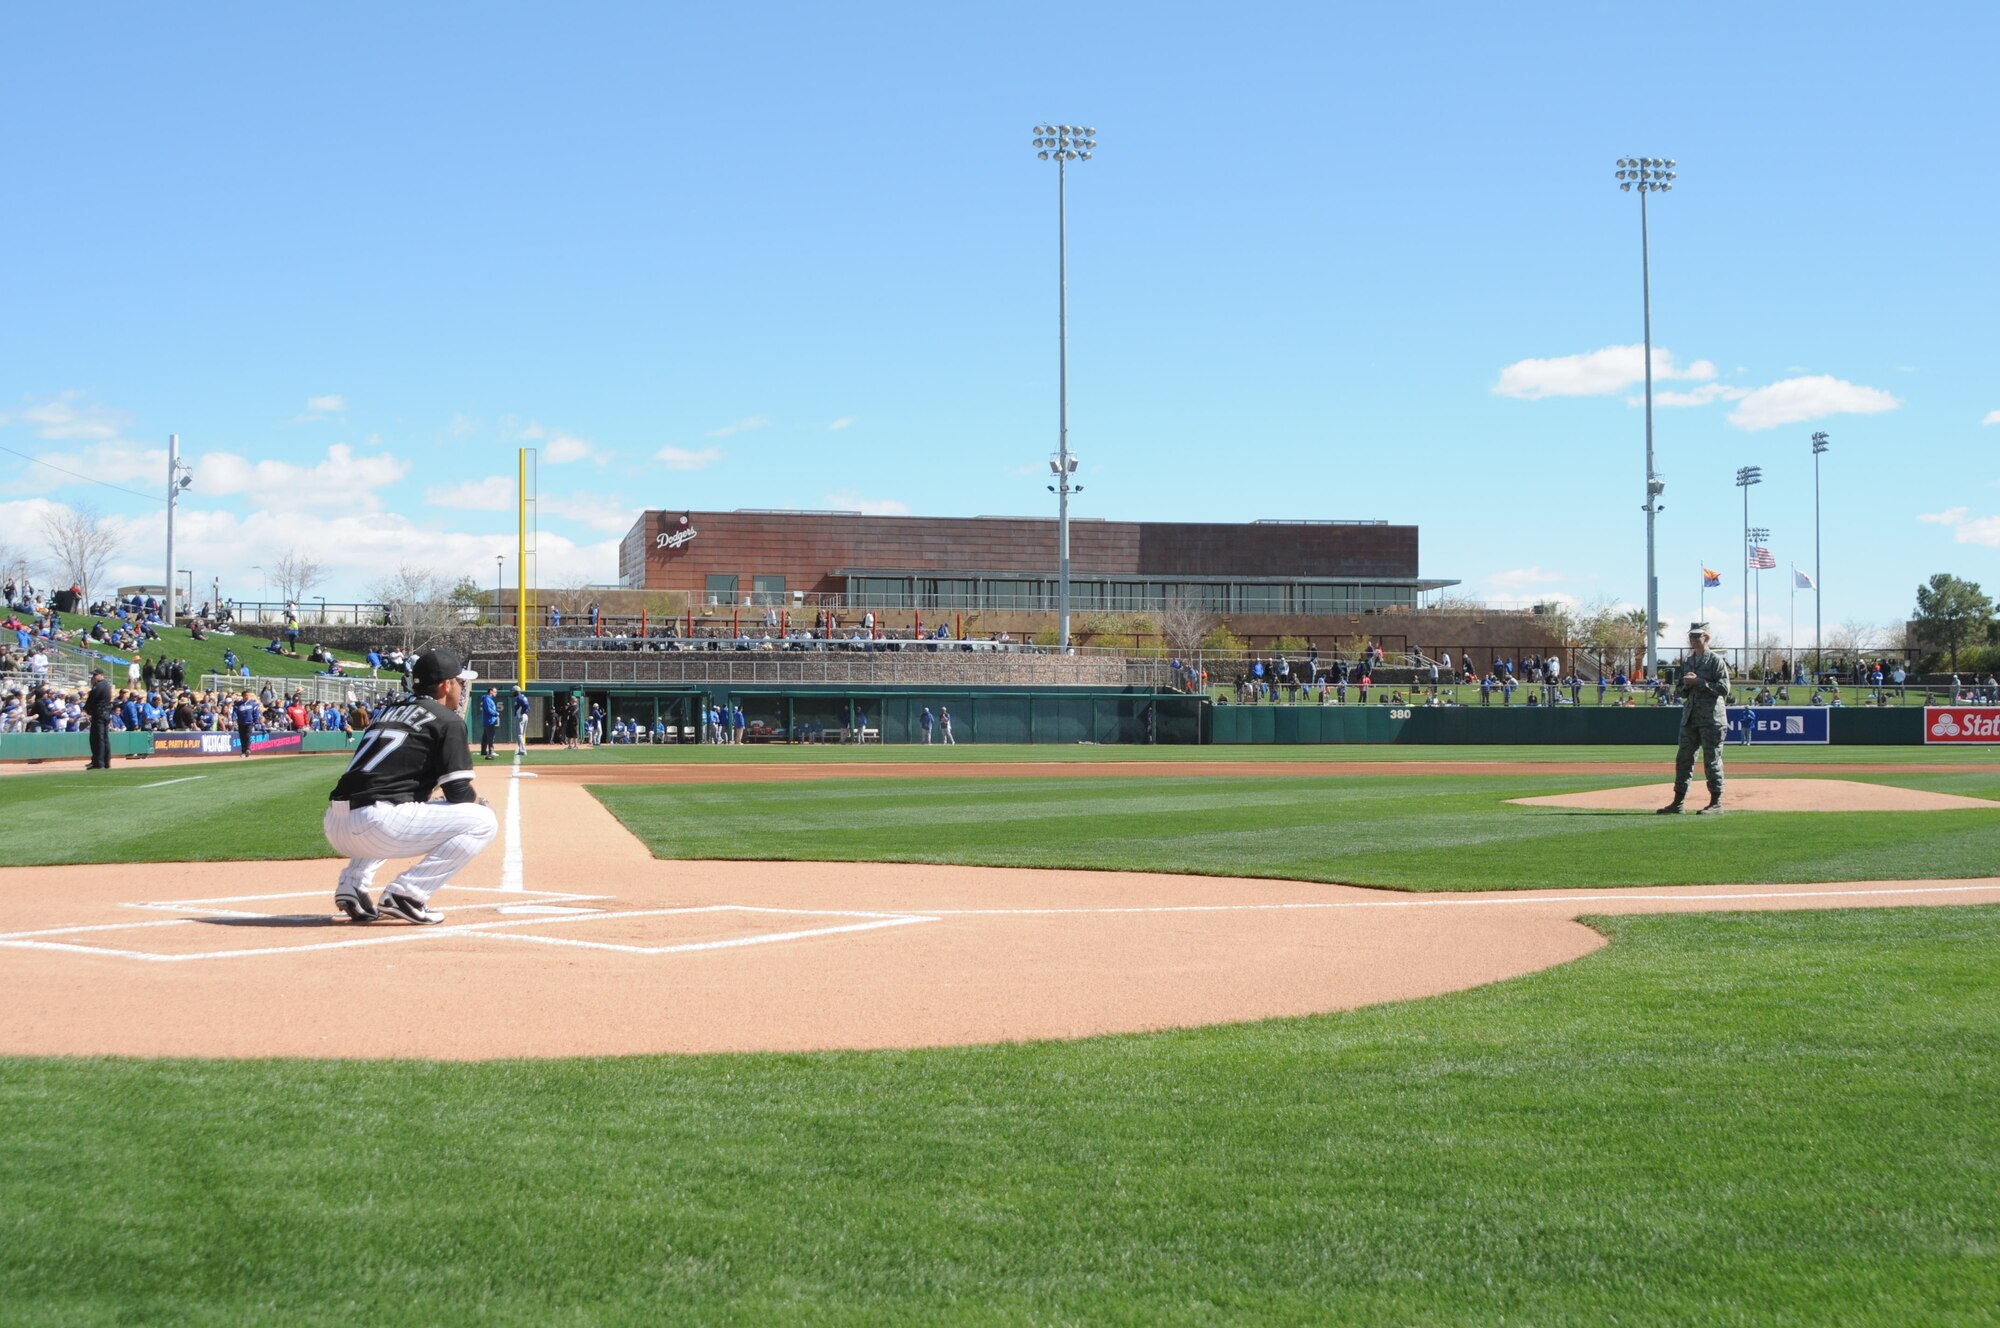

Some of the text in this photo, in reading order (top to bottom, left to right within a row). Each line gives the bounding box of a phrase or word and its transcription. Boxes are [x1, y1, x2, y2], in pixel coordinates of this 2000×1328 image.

[656, 526, 698, 549] Dodgers
[1389, 709, 1412, 719] 380
[345, 729, 409, 773] 77
